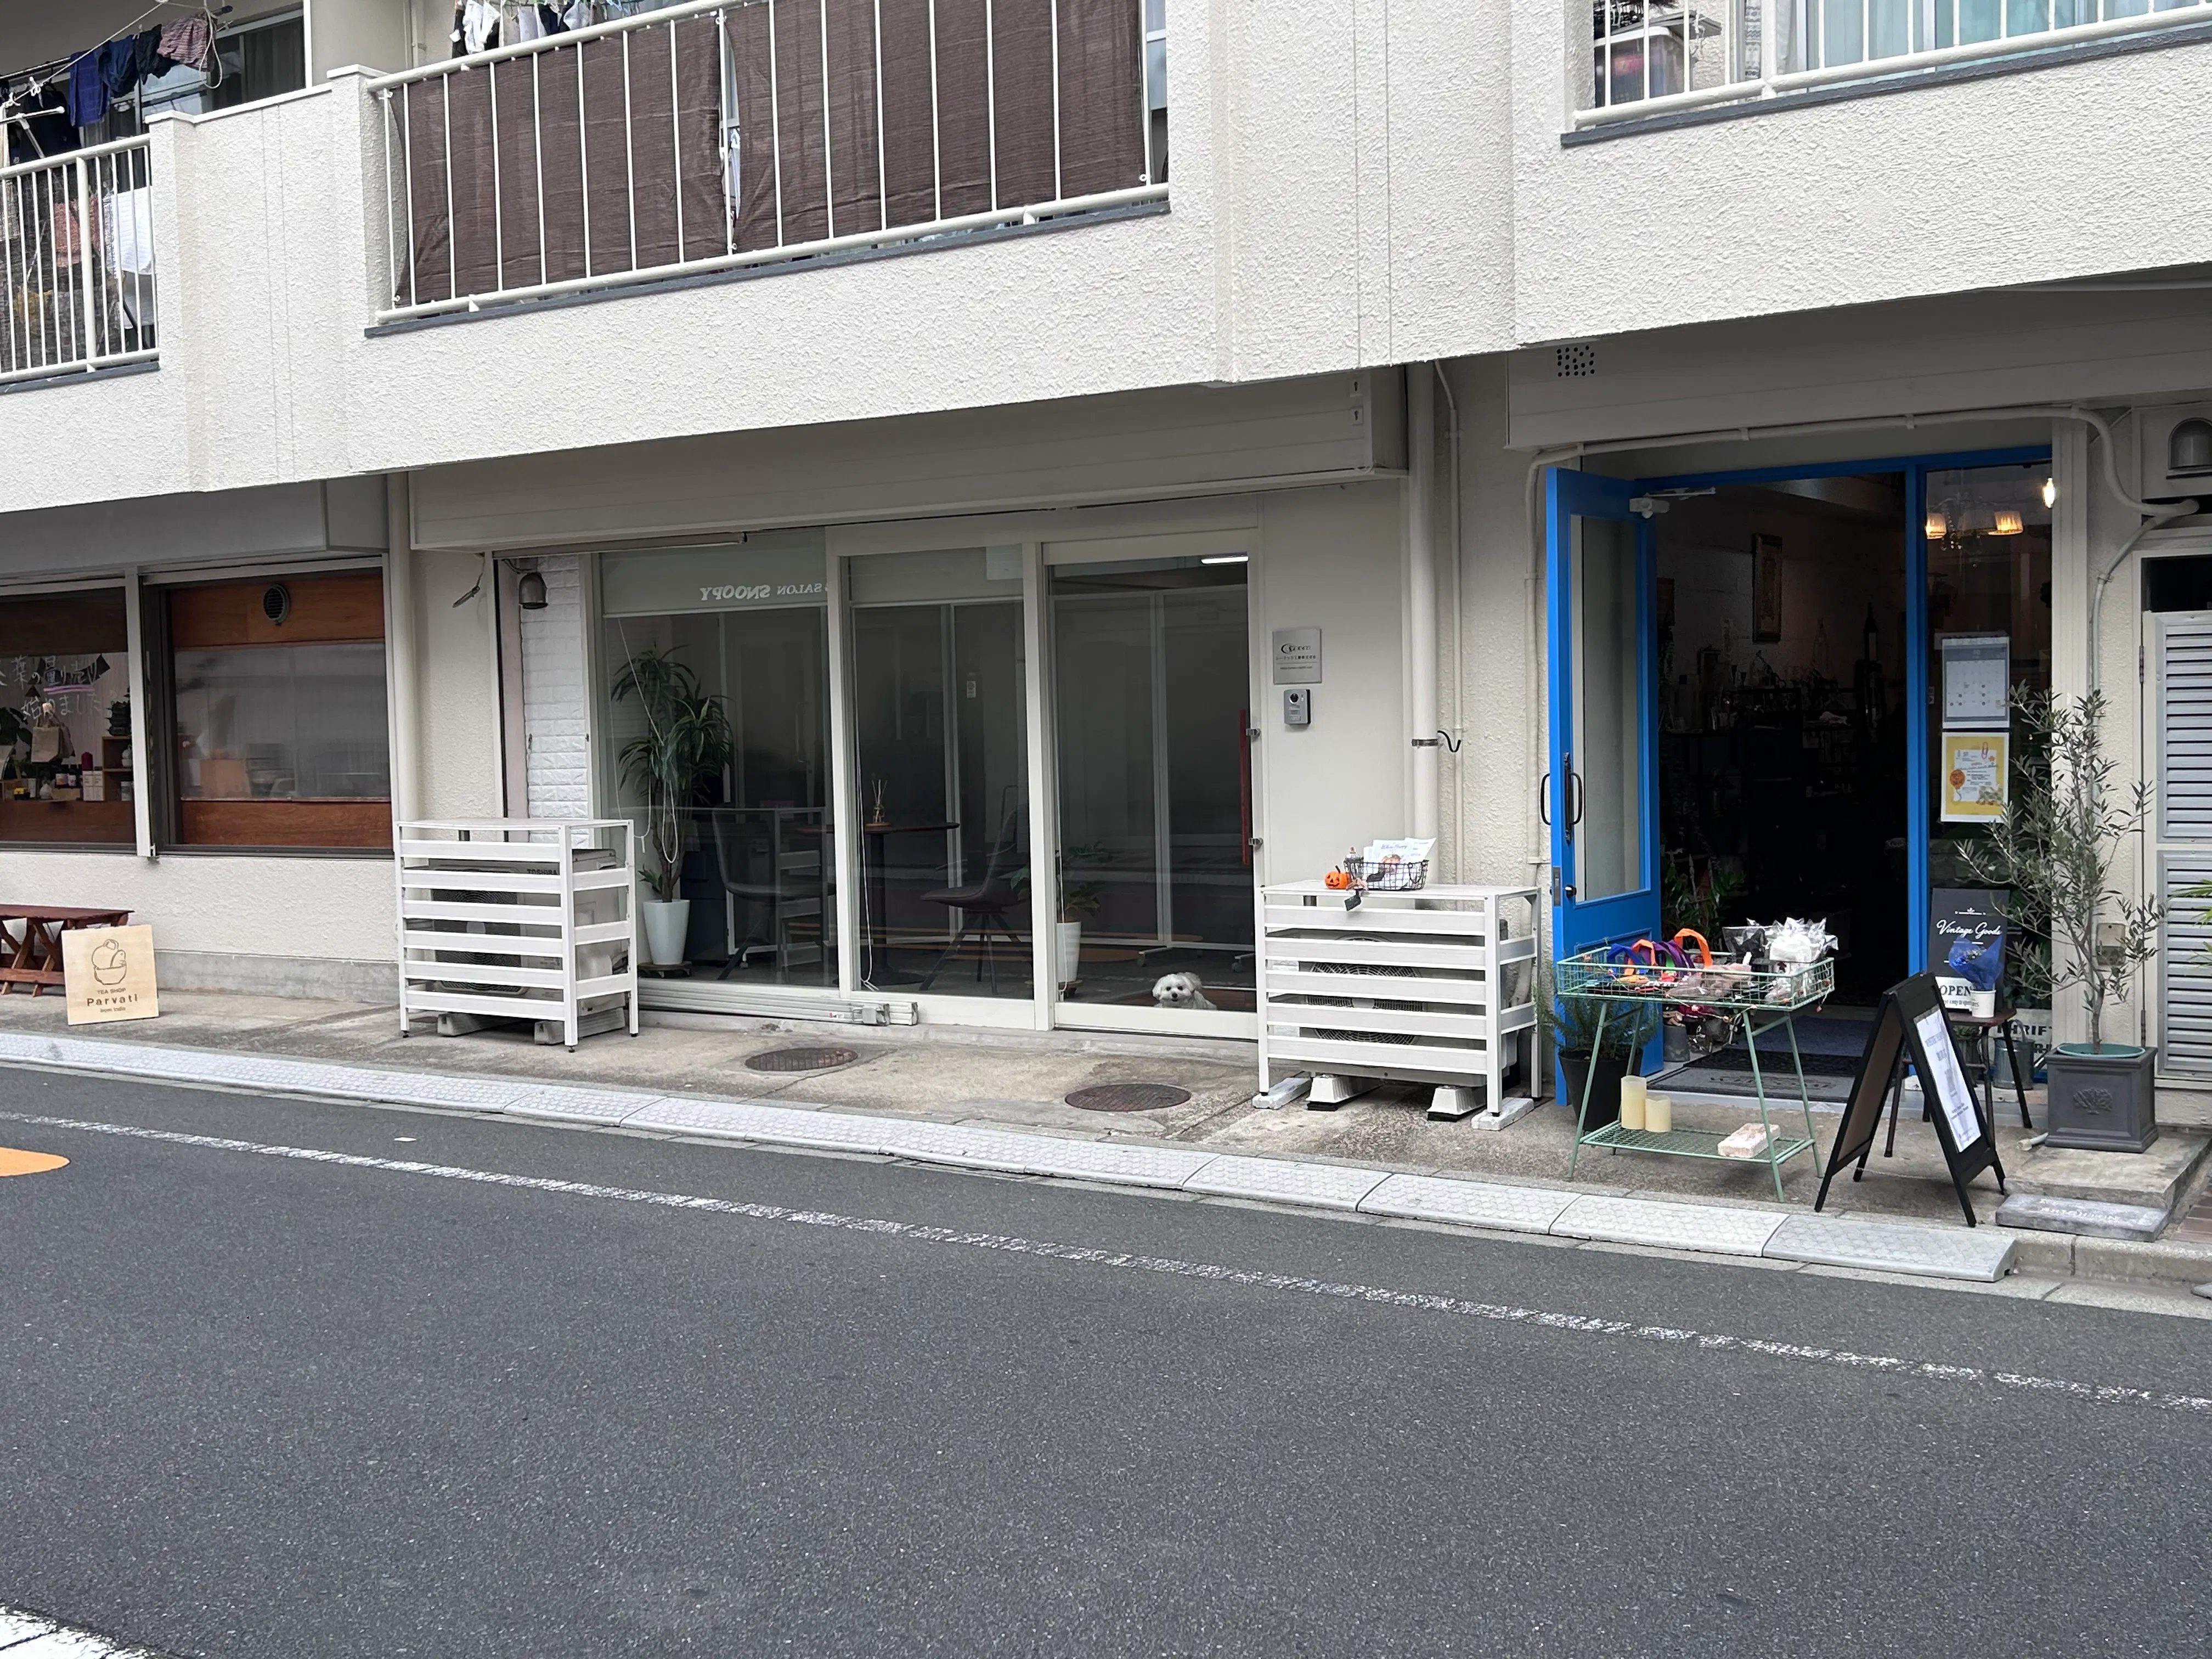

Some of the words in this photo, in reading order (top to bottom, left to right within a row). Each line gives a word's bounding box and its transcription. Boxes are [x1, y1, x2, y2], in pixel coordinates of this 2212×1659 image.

[1936, 919, 1973, 939] Vintage
[1974, 922, 2002, 939] Goods
[1939, 985, 1972, 996] OPEN
[87, 994, 138, 1006] Parvati
